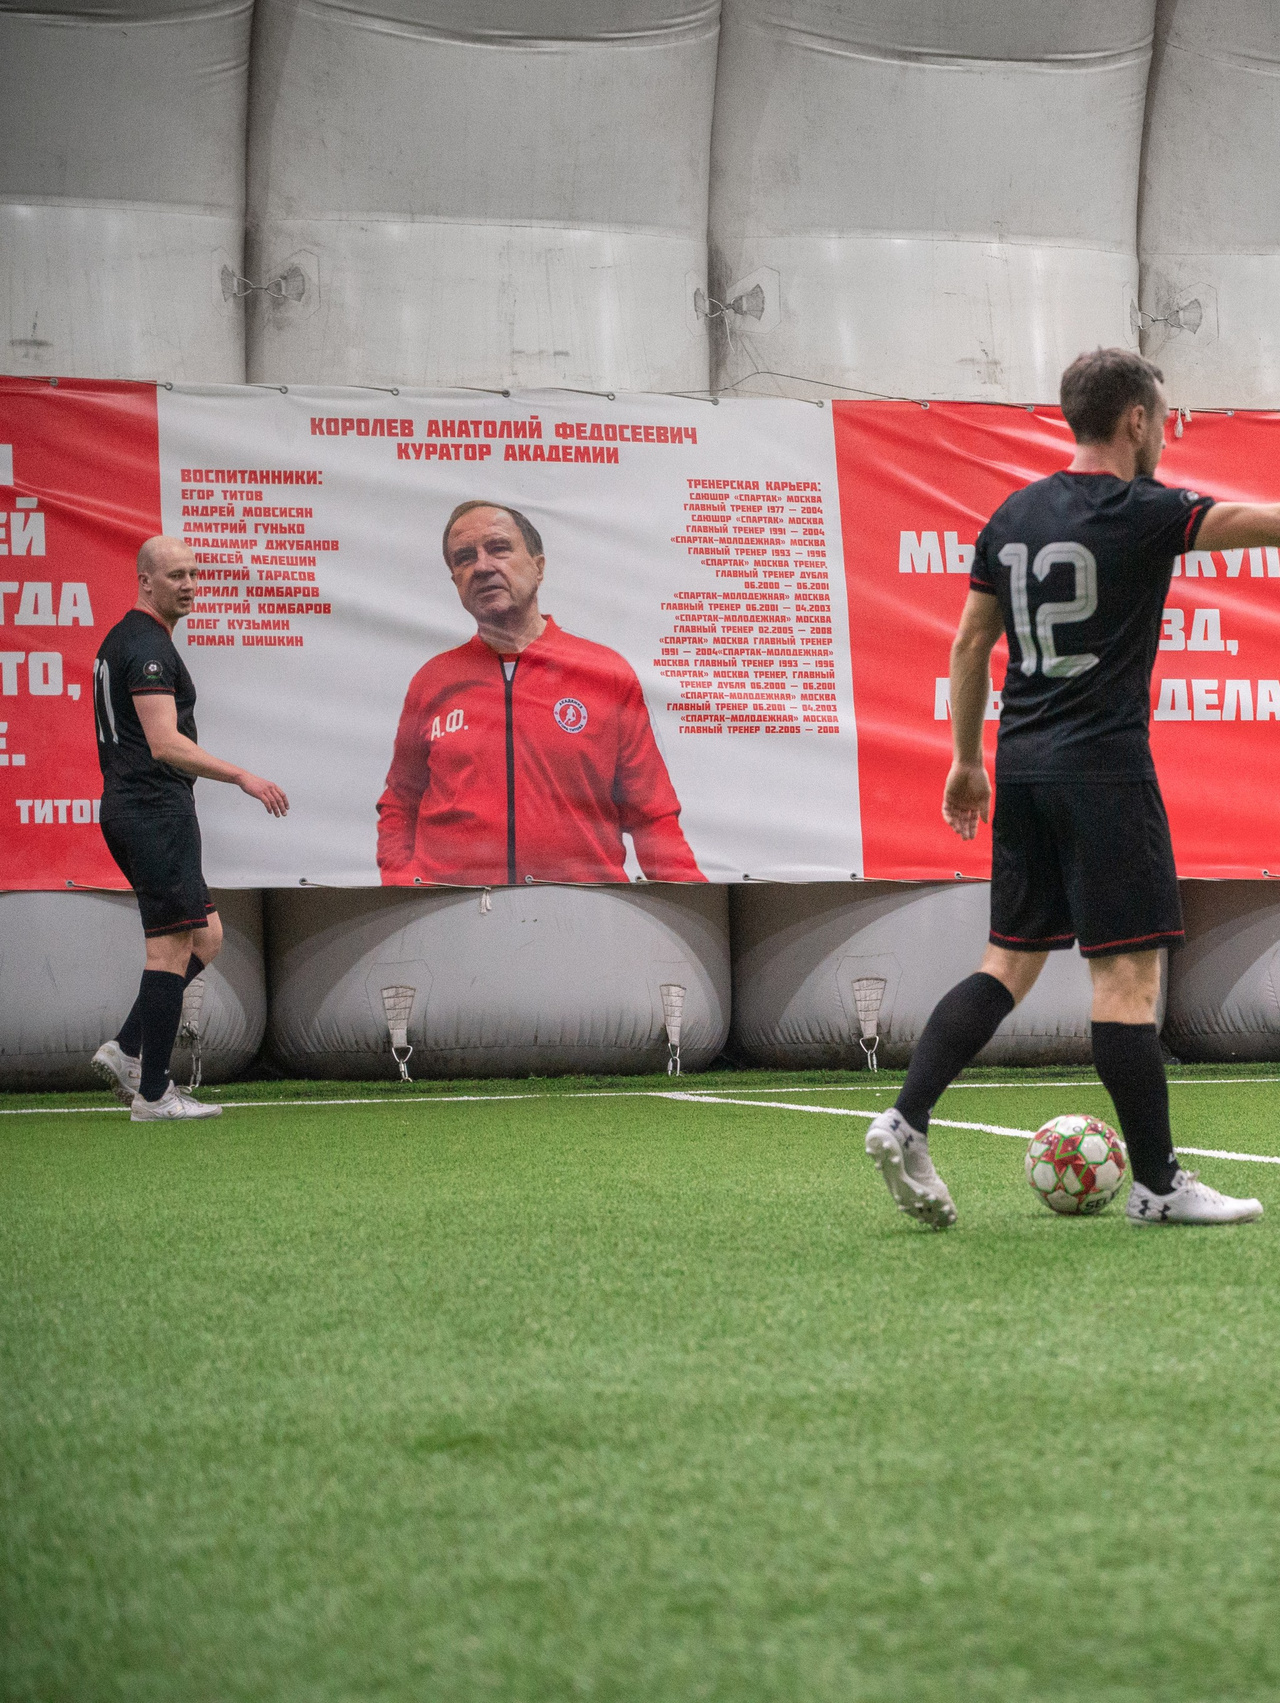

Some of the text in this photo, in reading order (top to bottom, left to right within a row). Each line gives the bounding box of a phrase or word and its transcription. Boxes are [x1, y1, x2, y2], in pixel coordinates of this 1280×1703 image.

[311, 415, 697, 444] КОРОЛЕВ АНАТОЛИЙ ФЕДОСЕЕВИЧ
[397, 443, 619, 464] КУРАТОР АКАДЕМИИ
[181, 469, 323, 485] ВОСПИТАННИКИ:
[687, 479, 820, 491] ТРЕНЕРСКАЯ КАРЬЕРА:
[182, 489, 263, 501] ЕГОР ТИТОВ
[690, 493, 822, 503] СДЮШОР «СПАРТАК» МОСКВА
[182, 503, 313, 518] АНДРЕЙ МОВСИСЯН
[684, 502, 726, 511] ГЛАВНЫЙ
[731, 505, 762, 513] ТРЕНЕР
[801, 506, 823, 514] 2004
[691, 514, 824, 525] СДЮШОР «СПАРТАК» МОСКВА
[183, 519, 305, 534] ДМИТРИЙ ГУНЬКО
[686, 524, 728, 533] ГЛАВНЫЙ
[733, 526, 765, 534] ТРЕНЕР
[803, 528, 825, 536] 2004
[182, 537, 339, 551] ВЛАДИМИР ДЖУБАНОВ
[672, 536, 826, 547] «СПАРТАК-МОЛОДЕЖНАЯ» МОСКВА
[688, 546, 730, 555] ГЛАВНЫЙ
[735, 548, 767, 556] ТРЕНЕР
[772, 549, 790, 557] 1993
[195, 551, 316, 566] ЛЕКСЕЙ МЕЛЕШИН
[702, 558, 749, 566] «СПАРТАК»
[197, 566, 315, 581] МИТРИЙ ТАРАСОВ
[716, 568, 828, 579] ГЛАВНЫЙ ТРЕНЕР ДУБЛЯ
[744, 581, 780, 589] 06.2000
[797, 582, 829, 590] 06.2001
[195, 586, 319, 597] ИРИЛЛ КОМБАРОВ
[674, 592, 830, 601] «СПАРТАК-МОЛОДЕЖНАЯ» МОСКВА
[258, 603, 331, 614] КОМБАРОВ
[661, 601, 704, 610] ГЛАВНЫЙ
[709, 603, 741, 611] ТРЕНЕР
[745, 604, 778, 612] 06.2001
[795, 604, 830, 612] 04.2003
[997, 541, 1099, 678] 12
[187, 619, 290, 630] ОЛЕГ КУЗЬМИН
[676, 614, 831, 624] «СПАРТАК-МОЛОДЕЖНАЯ» МОСКВА
[674, 623, 717, 633] ГЛАВНЫЙ
[758, 626, 793, 634] 02.2005
[810, 626, 832, 634] 2008
[188, 635, 303, 646] РОМАН ШИШКИН
[713, 637, 749, 645] МОСКВА
[753, 636, 796, 645] ГЛАВНЫЙ
[653, 659, 689, 667] МОСКВА
[694, 657, 737, 667] ГЛАВНЫЙ
[742, 659, 774, 667] ТРЕНЕР
[815, 660, 834, 668] 1996
[713, 670, 749, 678] МОСКВА
[792, 670, 835, 679] ГЛАВНЫЙ
[750, 682, 786, 690] 06.2000
[803, 682, 835, 690] 06.2001
[681, 692, 836, 701] «СПАРТАК-МОЛОДЕЖНАЯ» МОСКВА
[667, 701, 711, 711] ГЛАВНЫЙ
[716, 703, 748, 711] ТРЕНЕР
[753, 703, 785, 711] 06.2001
[681, 714, 797, 722] «СПАРТАК-МОЛОДЕЖНАЯ»
[679, 724, 723, 734] ГЛАВНЫЙ
[728, 726, 760, 734] ТРЕНЕР
[765, 726, 800, 734] 02.2005
[817, 726, 839, 734] 2008
